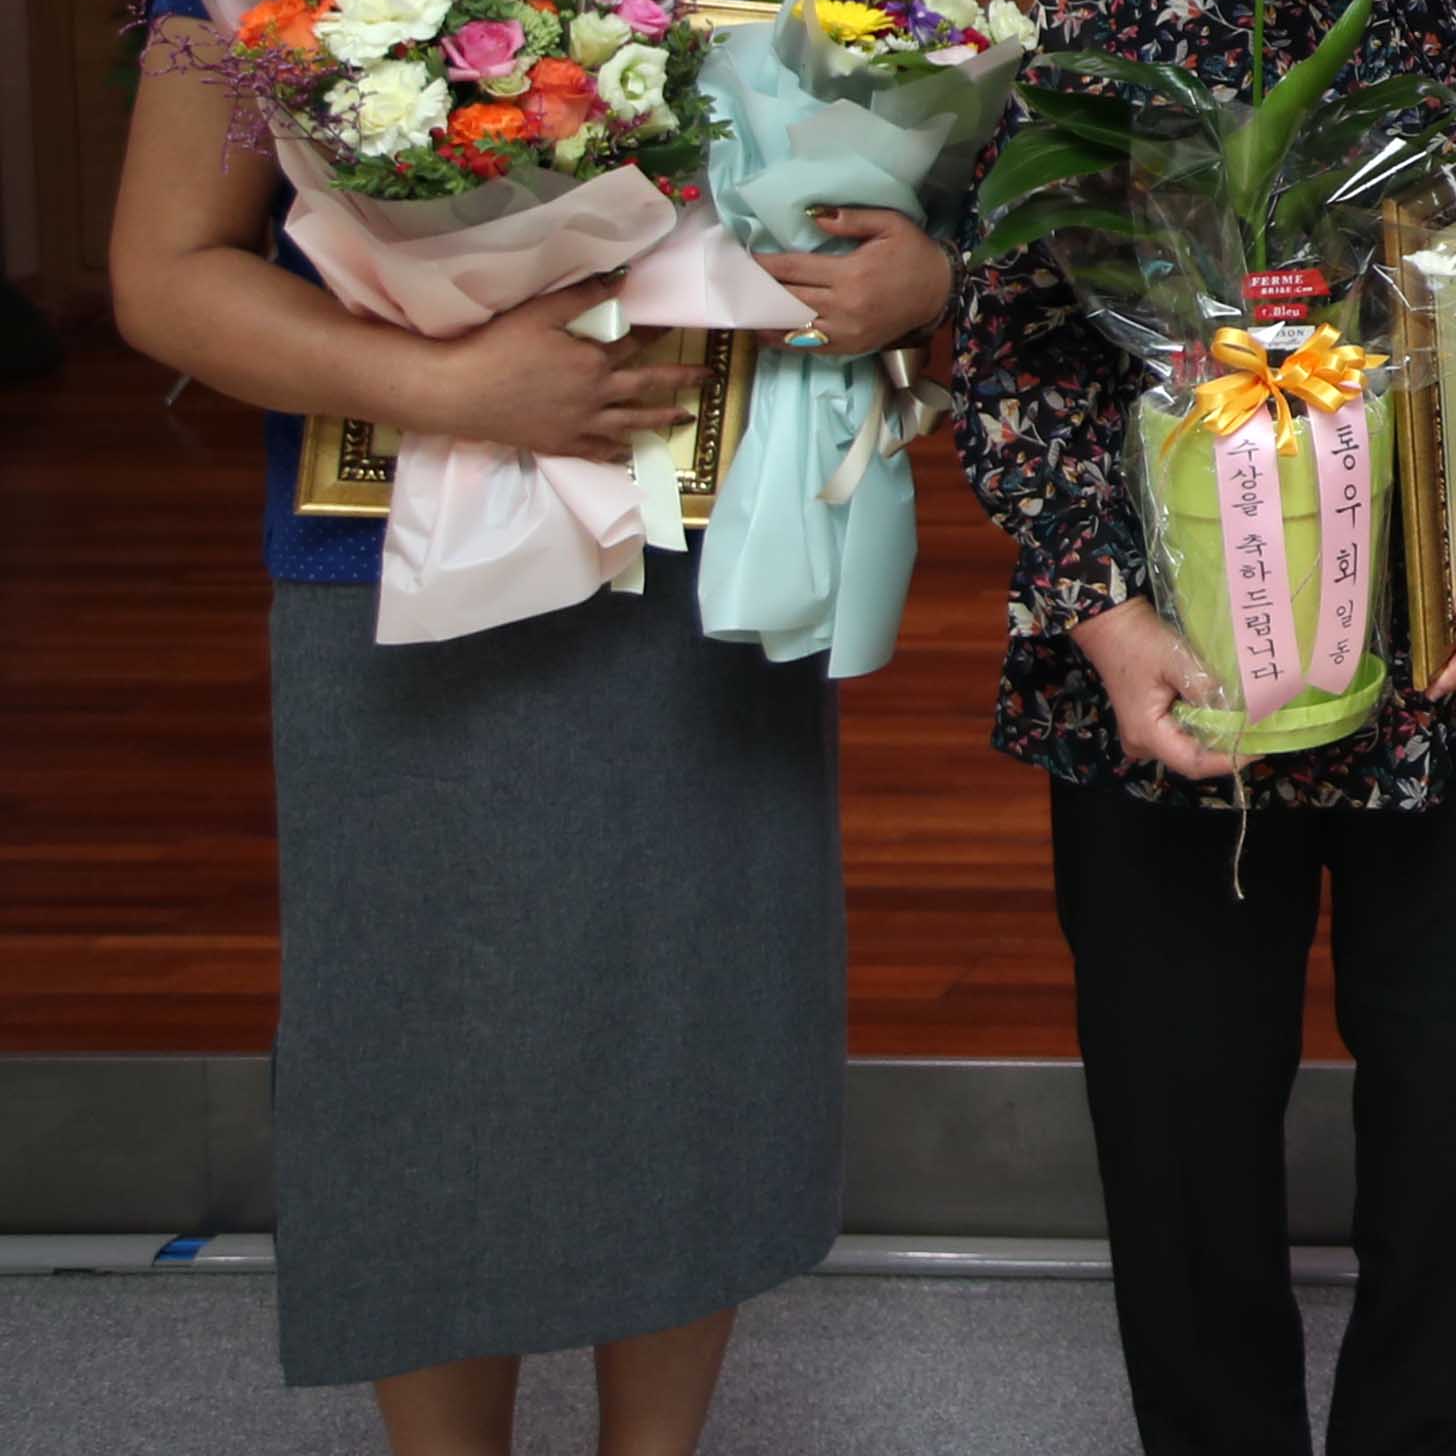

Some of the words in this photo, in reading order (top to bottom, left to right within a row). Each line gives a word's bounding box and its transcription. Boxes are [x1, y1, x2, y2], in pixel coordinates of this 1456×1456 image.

[1250, 274, 1304, 287] FERME
[1227, 438, 1264, 517] 수상을
[1235, 533, 1284, 682] 축하드립니다
